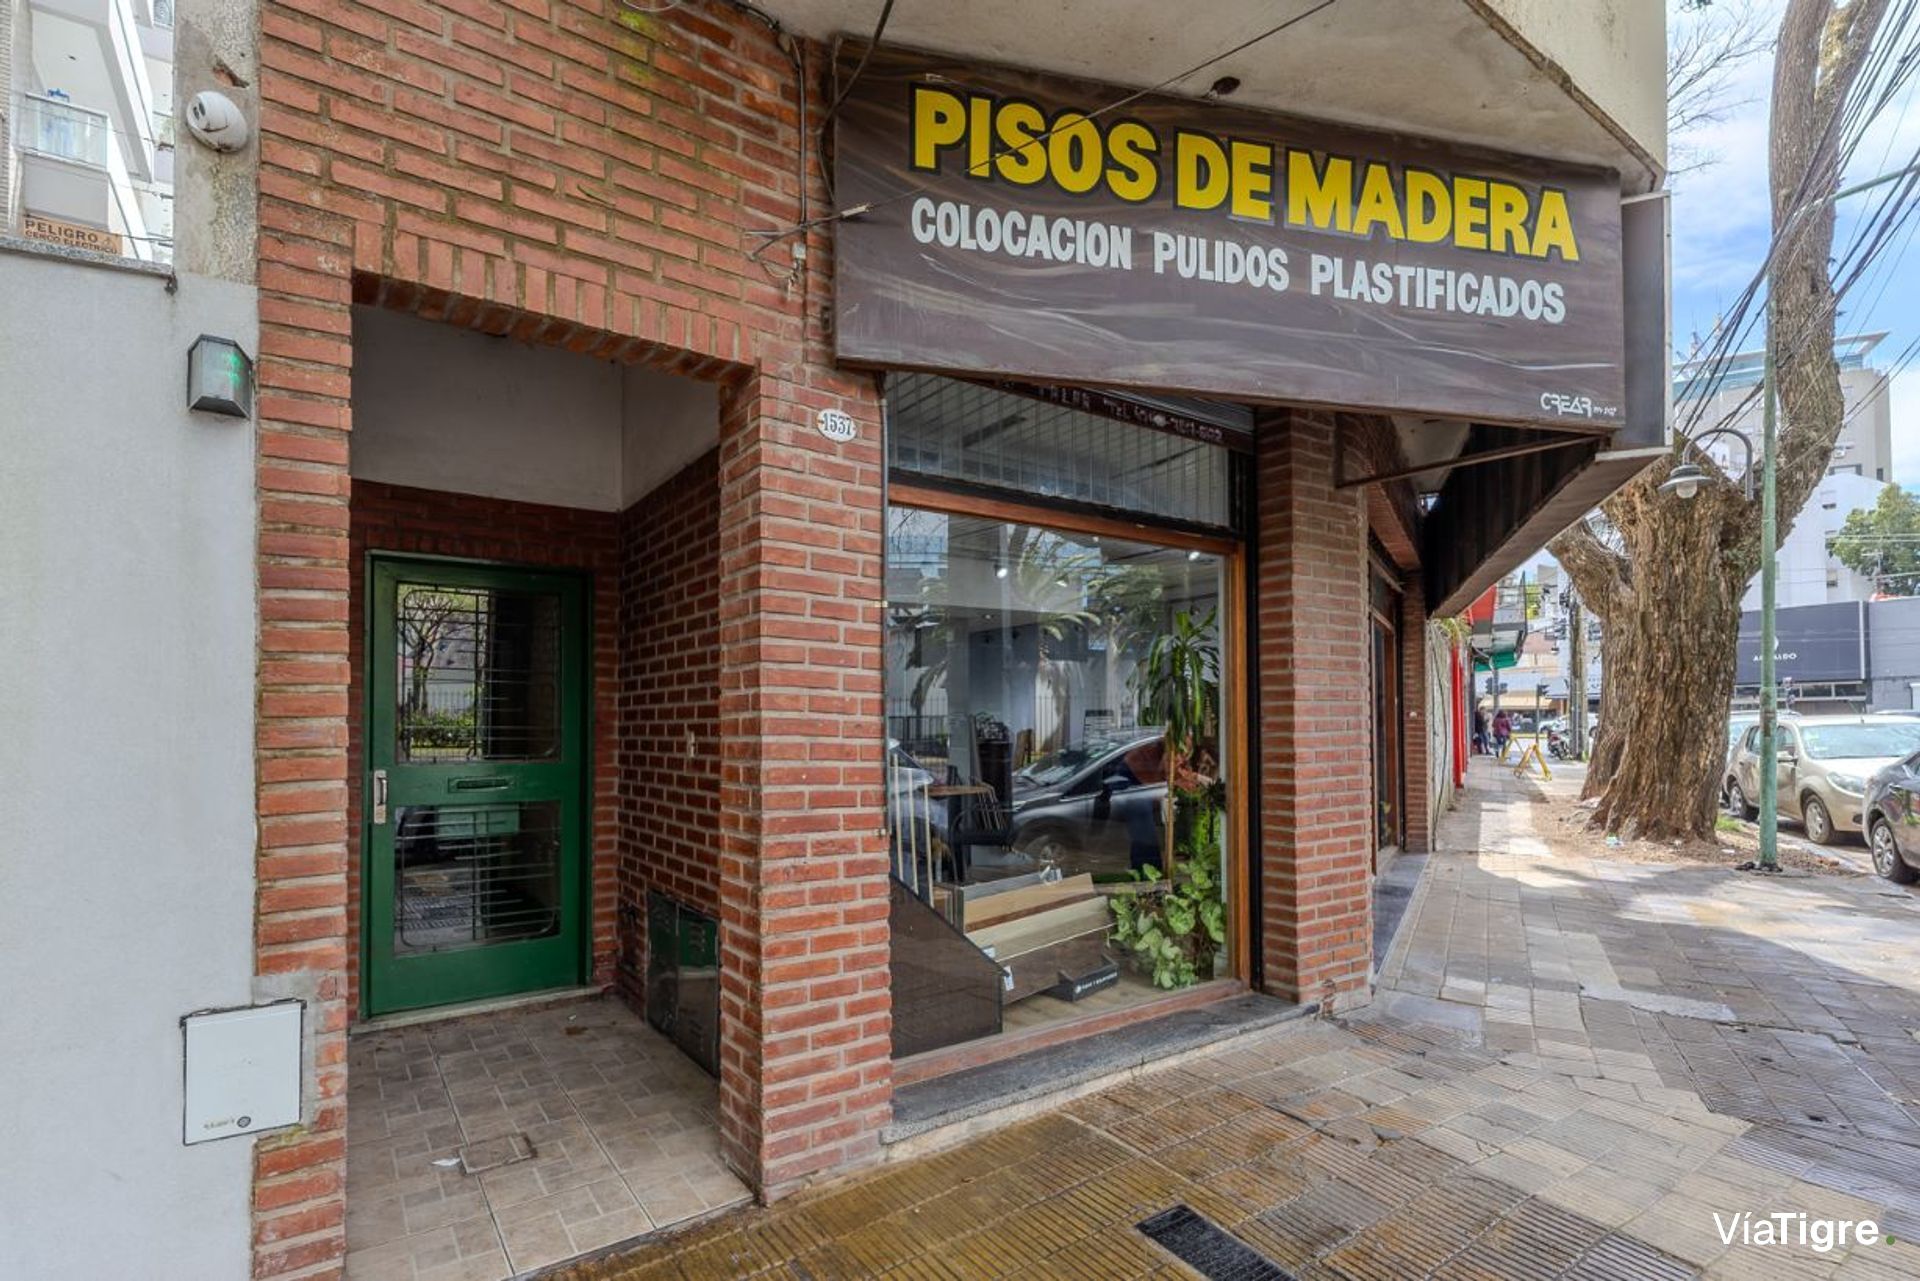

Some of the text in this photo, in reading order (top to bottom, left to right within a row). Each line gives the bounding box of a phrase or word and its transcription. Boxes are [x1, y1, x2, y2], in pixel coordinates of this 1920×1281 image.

[913, 91, 1578, 262] PISOS DE MADERA
[24, 219, 98, 243] PELIGRO
[25, 230, 60, 242] CERCO
[911, 198, 1567, 324] COLOCACION PULIDOS PLASTIFICADOS
[1540, 392, 1592, 418] CREAR
[822, 412, 853, 436] 1537
